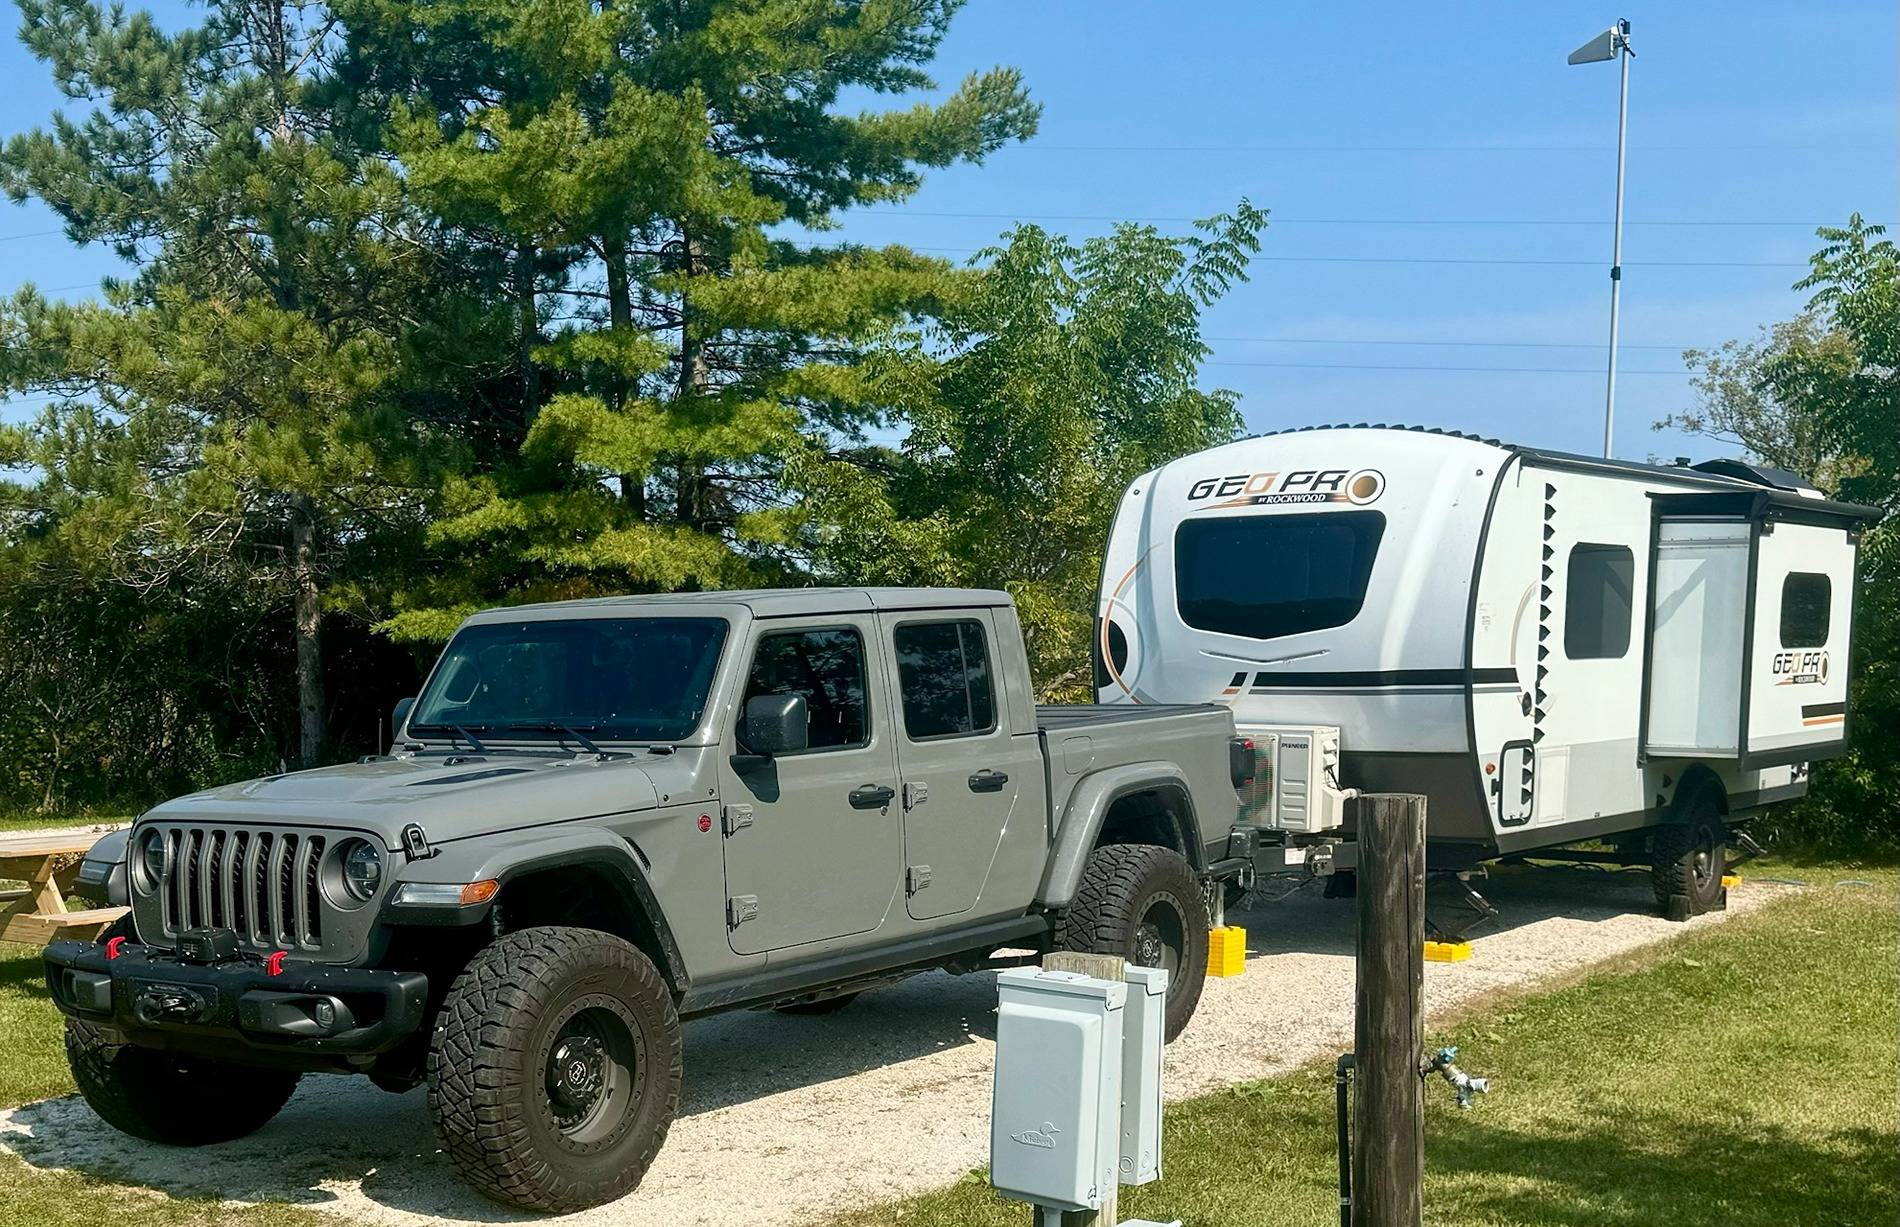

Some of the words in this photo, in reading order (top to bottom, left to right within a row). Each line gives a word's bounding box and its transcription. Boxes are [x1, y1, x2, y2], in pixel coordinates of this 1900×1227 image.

[1188, 472, 1280, 500] GEO
[1266, 494, 1326, 504] ROCKWOOD
[1773, 653, 1801, 674] GEO
